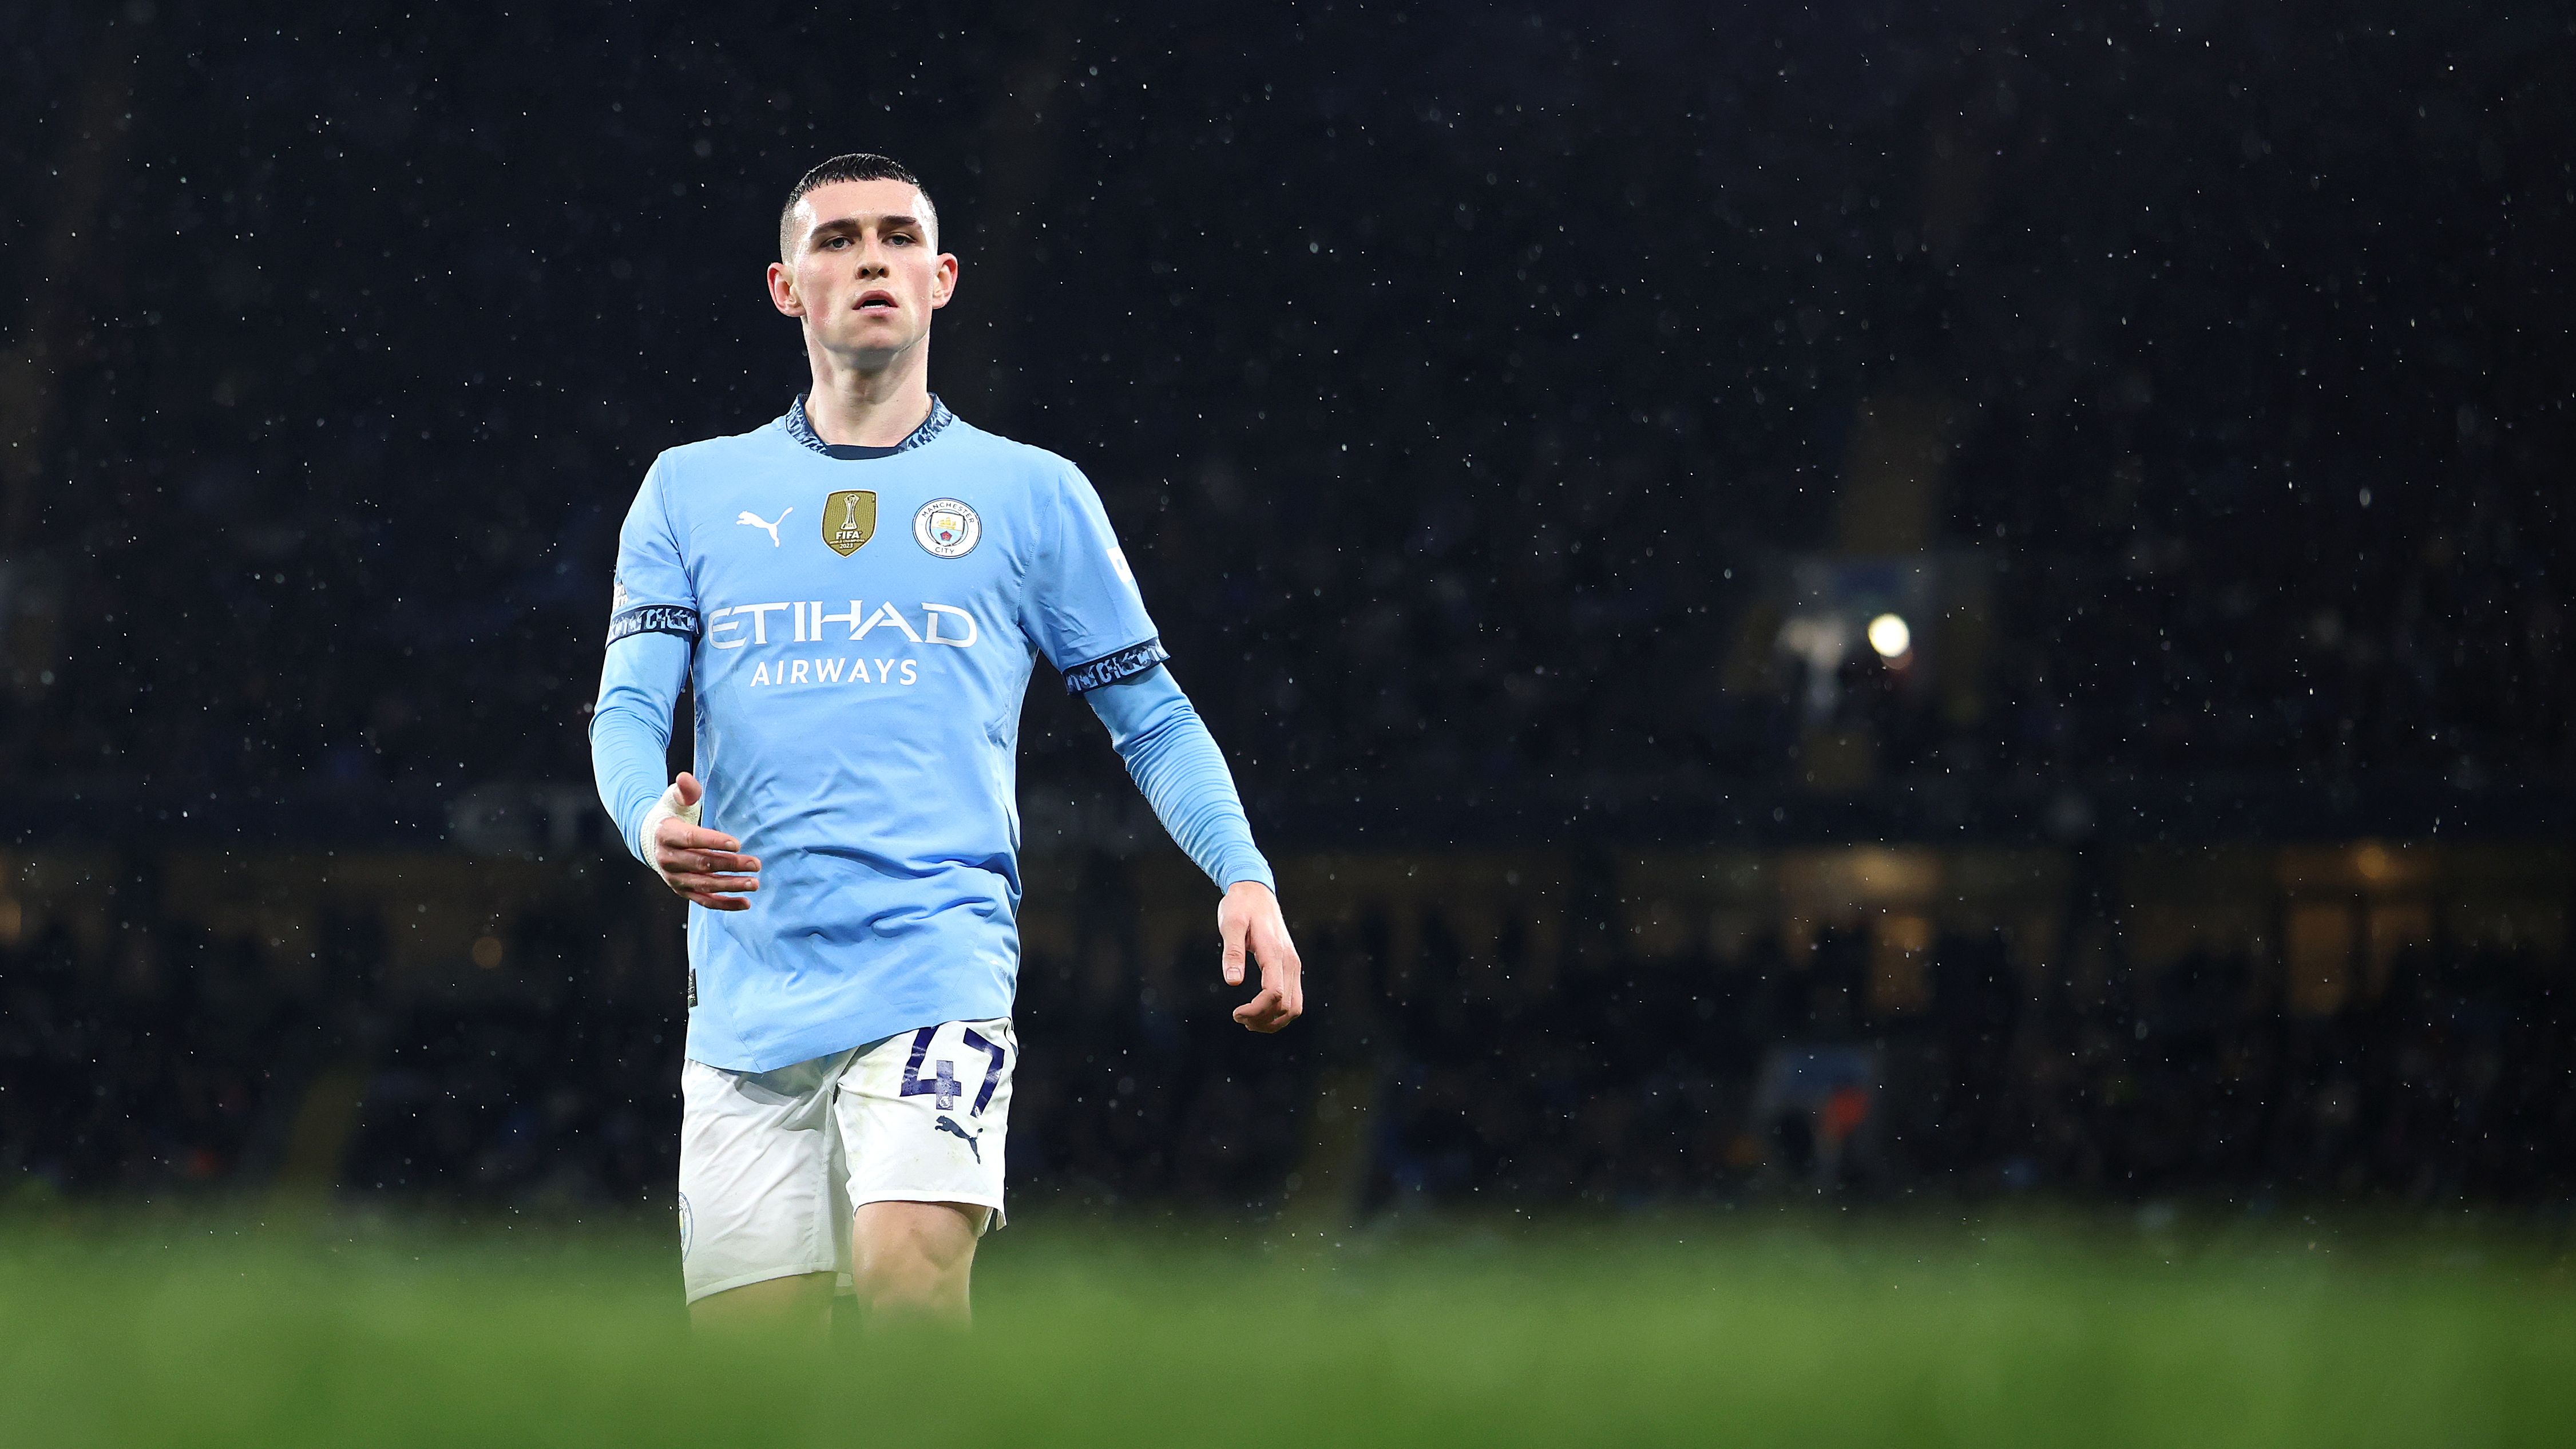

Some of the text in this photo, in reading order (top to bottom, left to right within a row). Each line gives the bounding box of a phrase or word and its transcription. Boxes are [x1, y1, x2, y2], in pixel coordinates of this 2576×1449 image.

[922, 502, 974, 523] MANCHESTER
[835, 530, 860, 540] FIFA
[708, 600, 977, 650] ETIHAD
[750, 658, 918, 687] AIRWAYS
[899, 1026, 1005, 1118] 47
